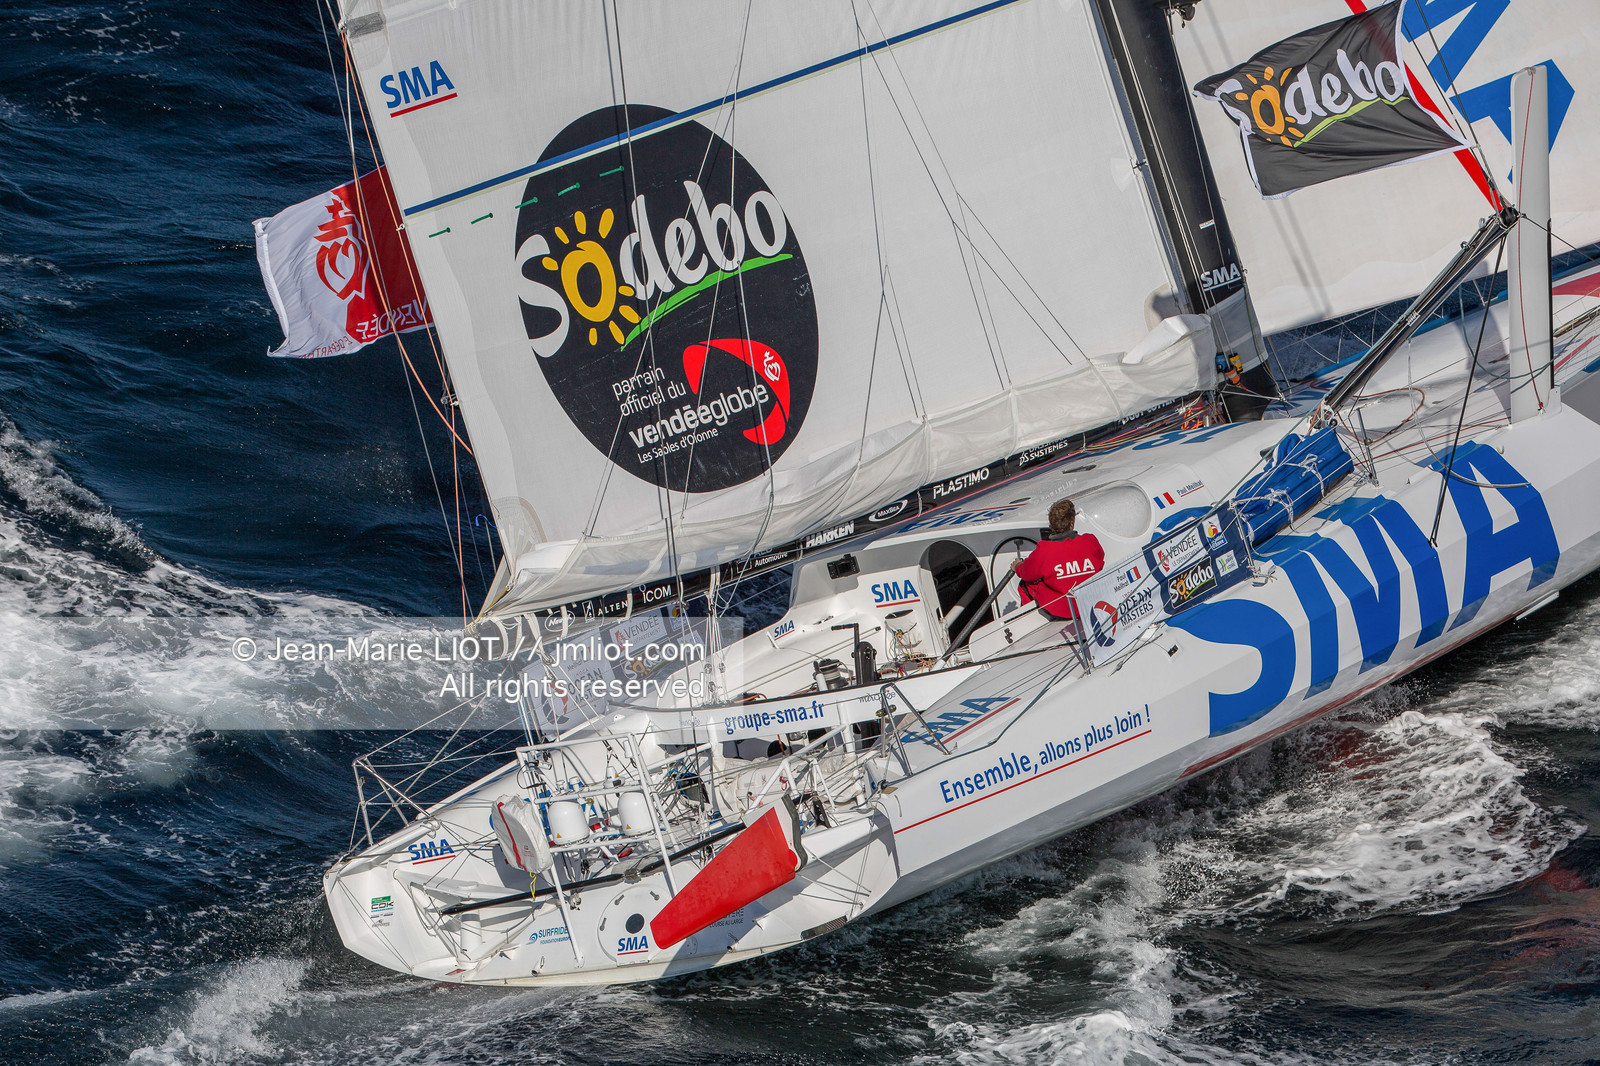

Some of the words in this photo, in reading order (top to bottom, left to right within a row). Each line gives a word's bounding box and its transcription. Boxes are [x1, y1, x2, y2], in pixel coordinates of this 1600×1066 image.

[380, 60, 455, 109] SMA
[1214, 48, 1406, 135] Sodebo
[514, 180, 789, 358] Sodebo
[1200, 262, 1241, 289] SMA
[612, 366, 666, 401] parrain
[620, 386, 666, 417] officiel
[667, 381, 687, 399] du
[637, 452, 653, 464] Les
[652, 442, 680, 459] Sables
[933, 467, 990, 499] PLASTIMO
[1176, 488, 1186, 497] Paul
[806, 521, 855, 549] HARKEN
[1165, 534, 1198, 559] VENDÉE
[754, 550, 788, 568] Automotive
[1054, 558, 1096, 576] SMA
[871, 579, 919, 603] SMA
[1165, 440, 1561, 738] SMA
[1169, 563, 1214, 603] Sodebo
[598, 600, 628, 616] ALTEN
[1119, 587, 1152, 615] OCEAN
[1121, 601, 1154, 627] MASTERS
[774, 620, 796, 637] SMA
[724, 700, 825, 735] groupe-sma.fr
[900, 696, 1011, 745] SMA
[939, 752, 1039, 804] Ensemble,
[1039, 735, 1081, 765] allons
[1084, 722, 1113, 752] plus
[1115, 710, 1142, 733] loin
[408, 838, 454, 861] SMA
[538, 926, 569, 938] SURFRIDE
[731, 918, 744, 926] LARGE
[617, 936, 649, 951] SMA
